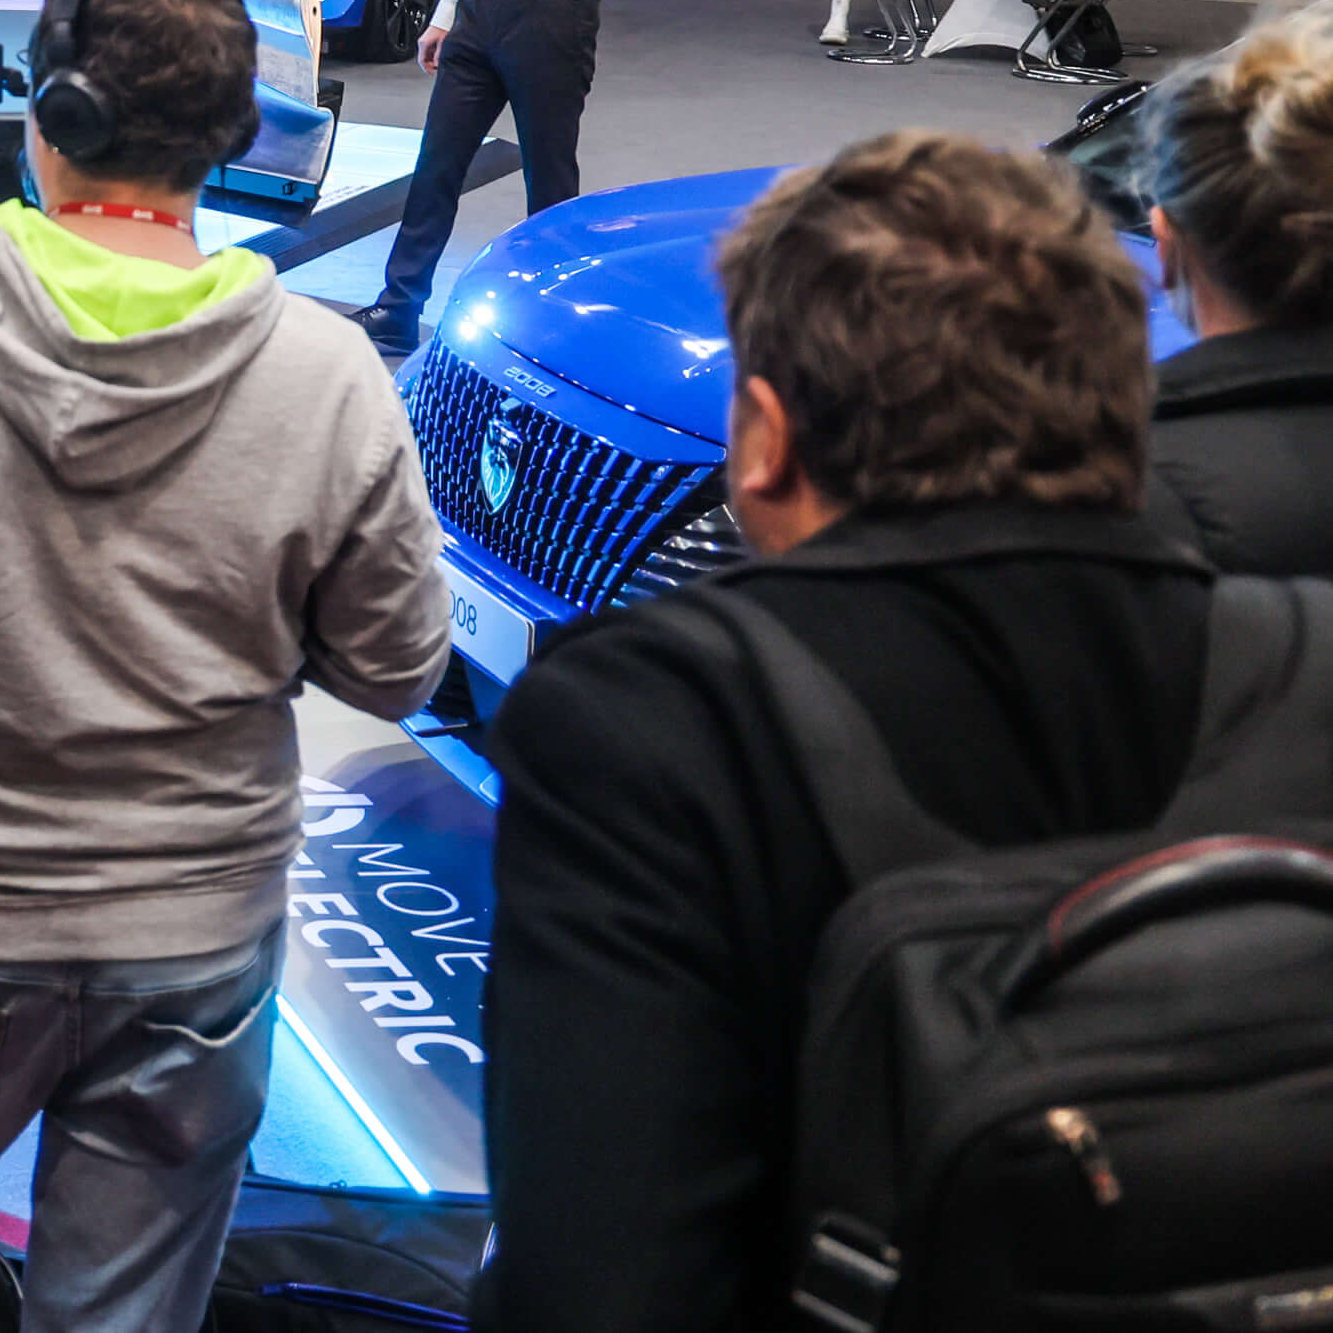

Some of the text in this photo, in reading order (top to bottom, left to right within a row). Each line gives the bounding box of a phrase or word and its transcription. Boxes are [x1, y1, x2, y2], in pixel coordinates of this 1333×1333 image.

[503, 366, 556, 398] 2008
[449, 589, 477, 636] 008
[332, 843, 490, 976] MOVE
[286, 850, 486, 1066] ECTRIC
